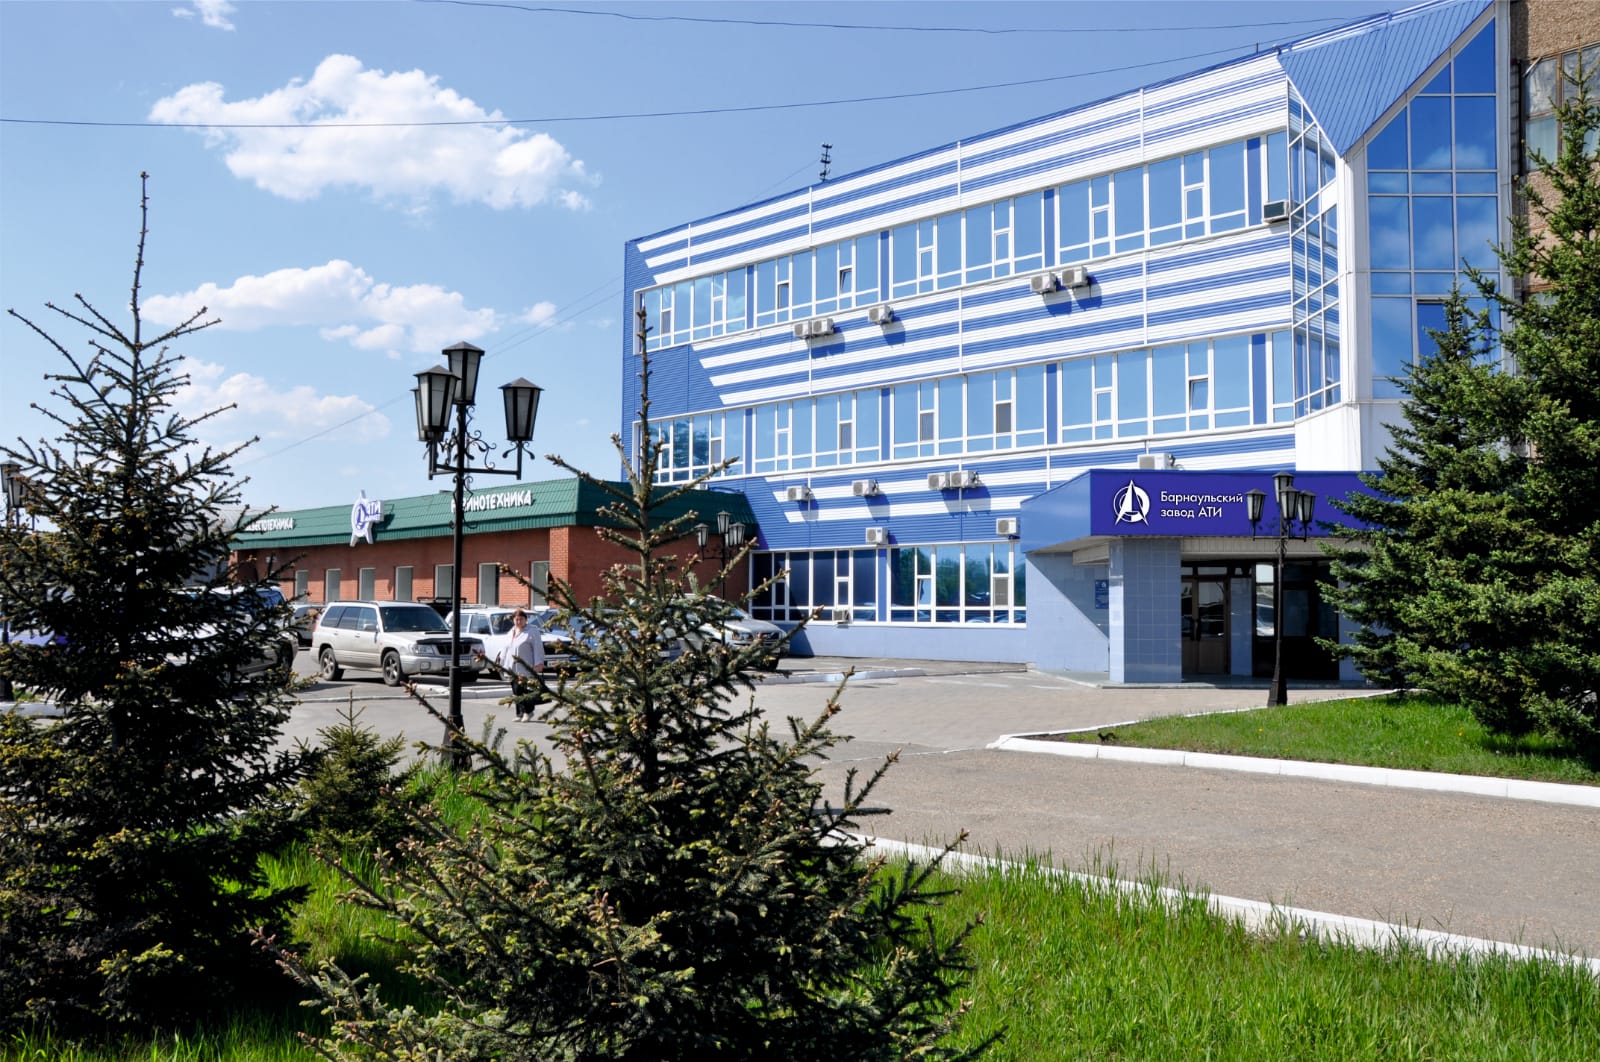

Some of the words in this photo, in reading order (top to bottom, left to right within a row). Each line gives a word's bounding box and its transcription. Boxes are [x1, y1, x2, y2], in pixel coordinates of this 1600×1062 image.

[1160, 490, 1243, 506] Барнаульский
[1160, 508, 1195, 519] завод
[1198, 506, 1223, 518] АТИ
